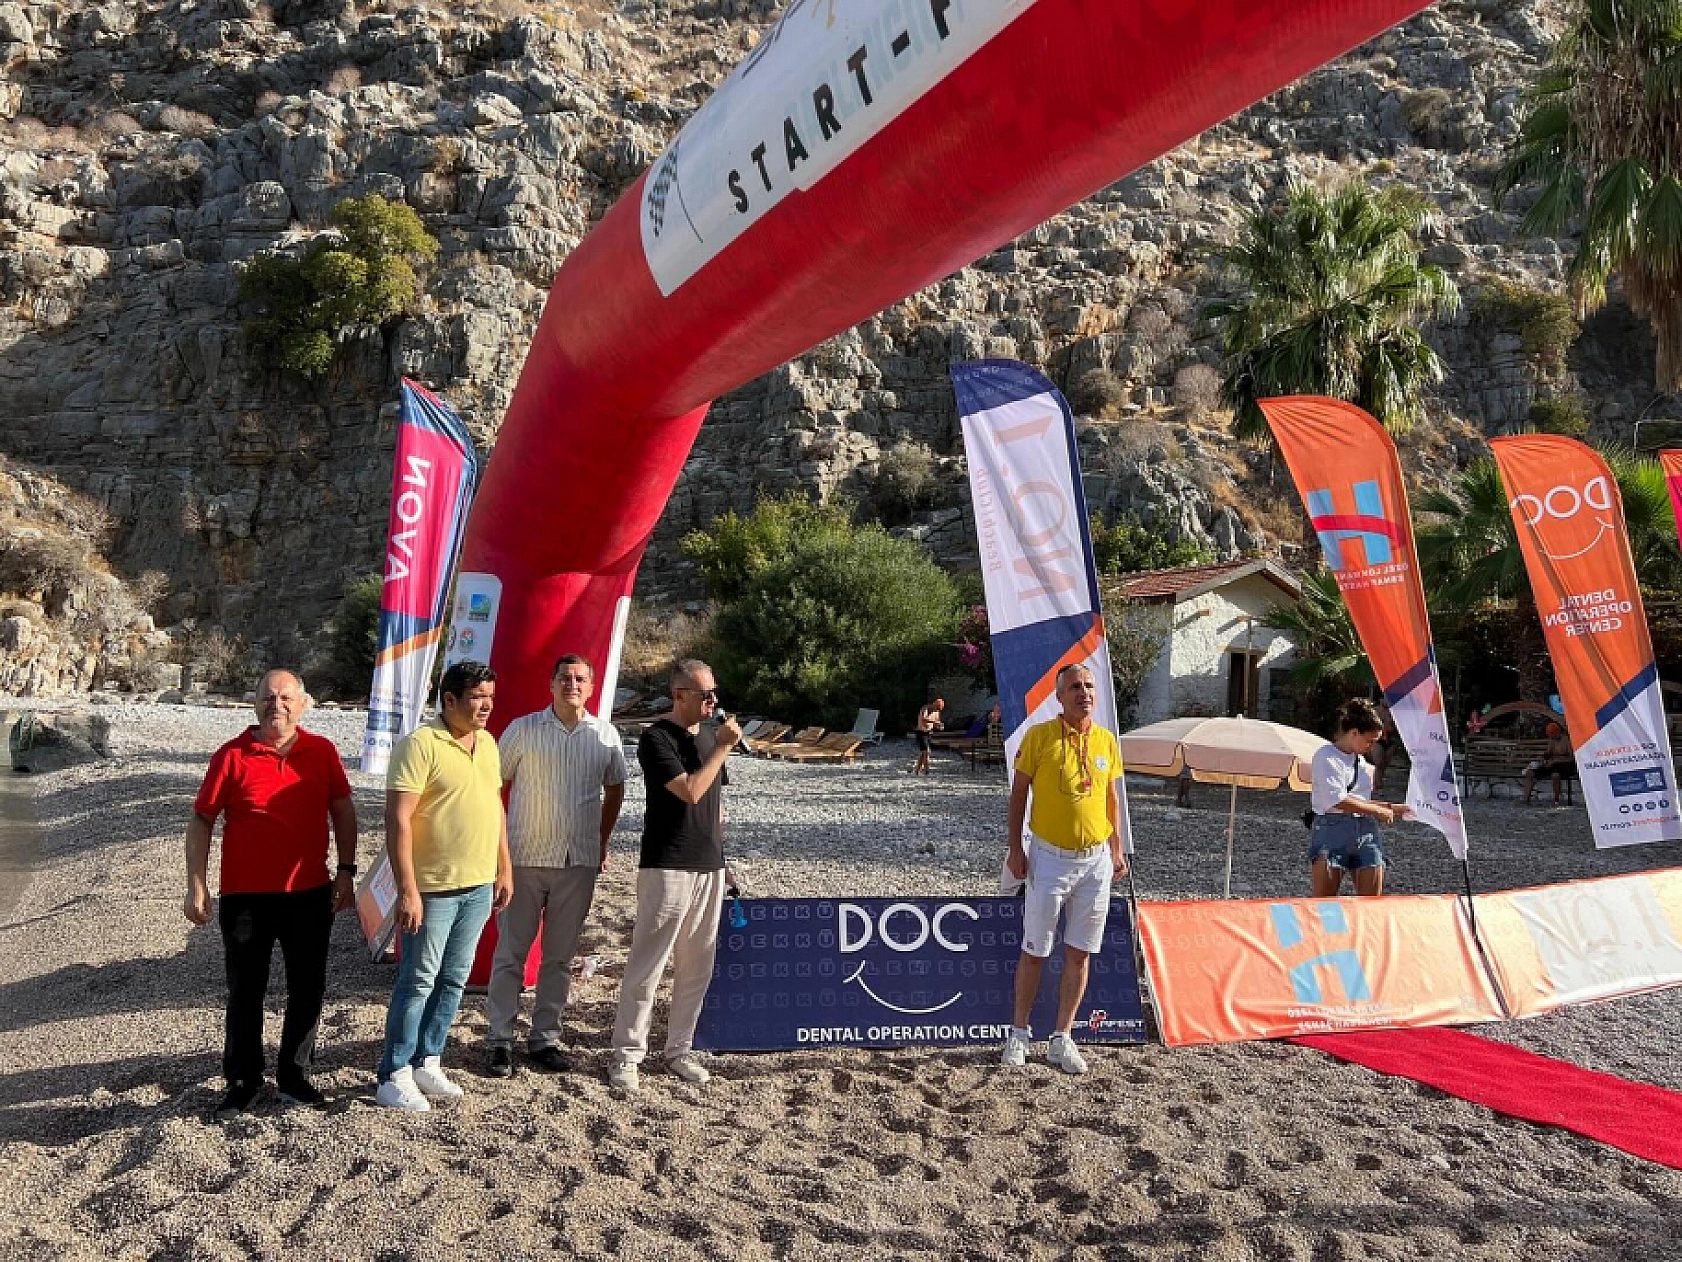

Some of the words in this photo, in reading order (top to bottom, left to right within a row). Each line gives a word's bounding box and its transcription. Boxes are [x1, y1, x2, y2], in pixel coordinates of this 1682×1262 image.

[838, 902, 980, 953] DOC
[796, 1025, 864, 1043] DENTAL
[867, 1024, 965, 1041] OPERATION
